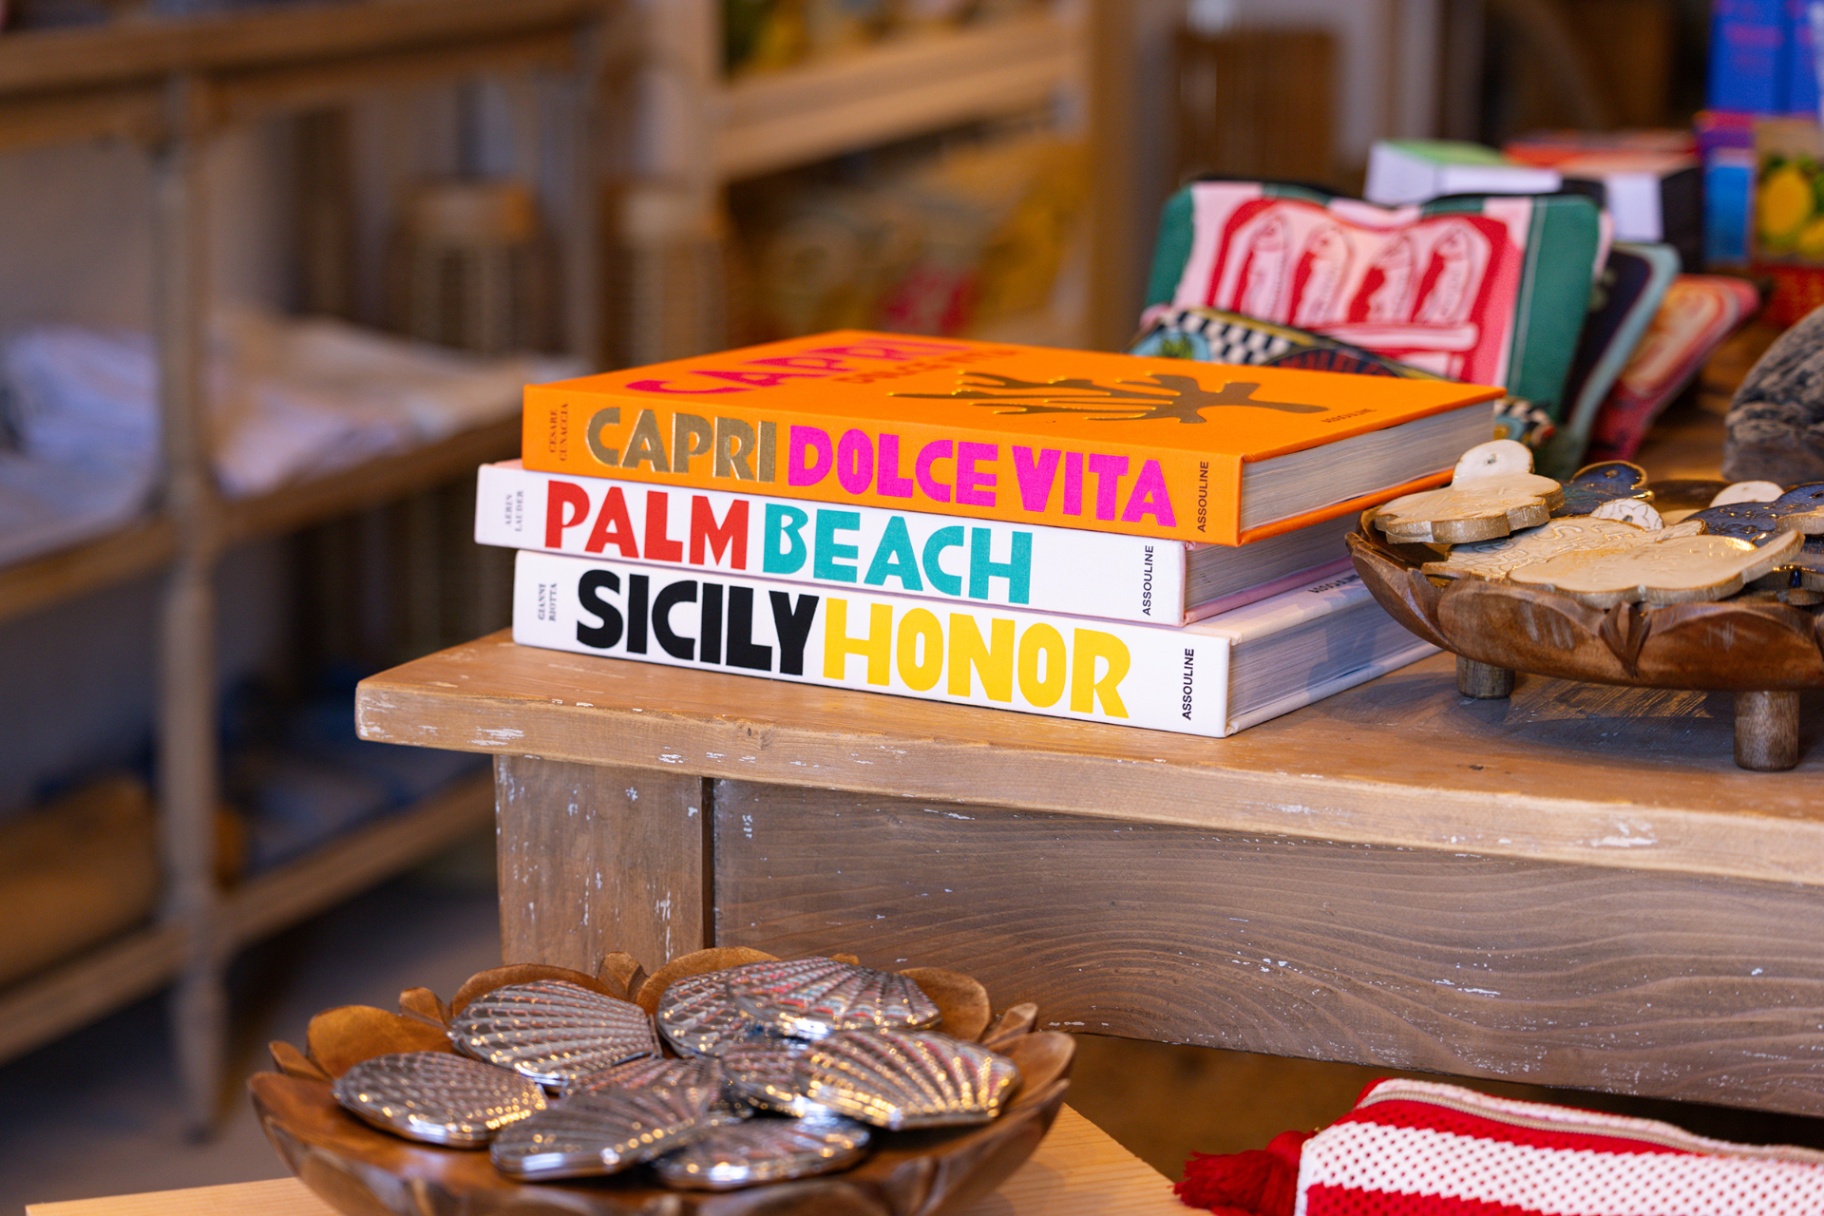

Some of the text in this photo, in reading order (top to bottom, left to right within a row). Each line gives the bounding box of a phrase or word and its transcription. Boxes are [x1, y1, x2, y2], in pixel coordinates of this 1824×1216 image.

[625, 338, 972, 395] CAPRI
[549, 410, 558, 453] CESARE
[586, 406, 1177, 528] CAPRI DOLCE VITA
[514, 490, 524, 532] LAUDER
[1197, 460, 1210, 533] ASSOULINE
[545, 480, 1033, 605] PALM BEACH
[537, 583, 546, 621] GIANNI
[549, 583, 557, 621] RIOTTA
[1142, 544, 1155, 617] ASSOULINE
[576, 569, 1131, 719] SICILY HONOR
[1182, 648, 1195, 721] ASSOULINE
